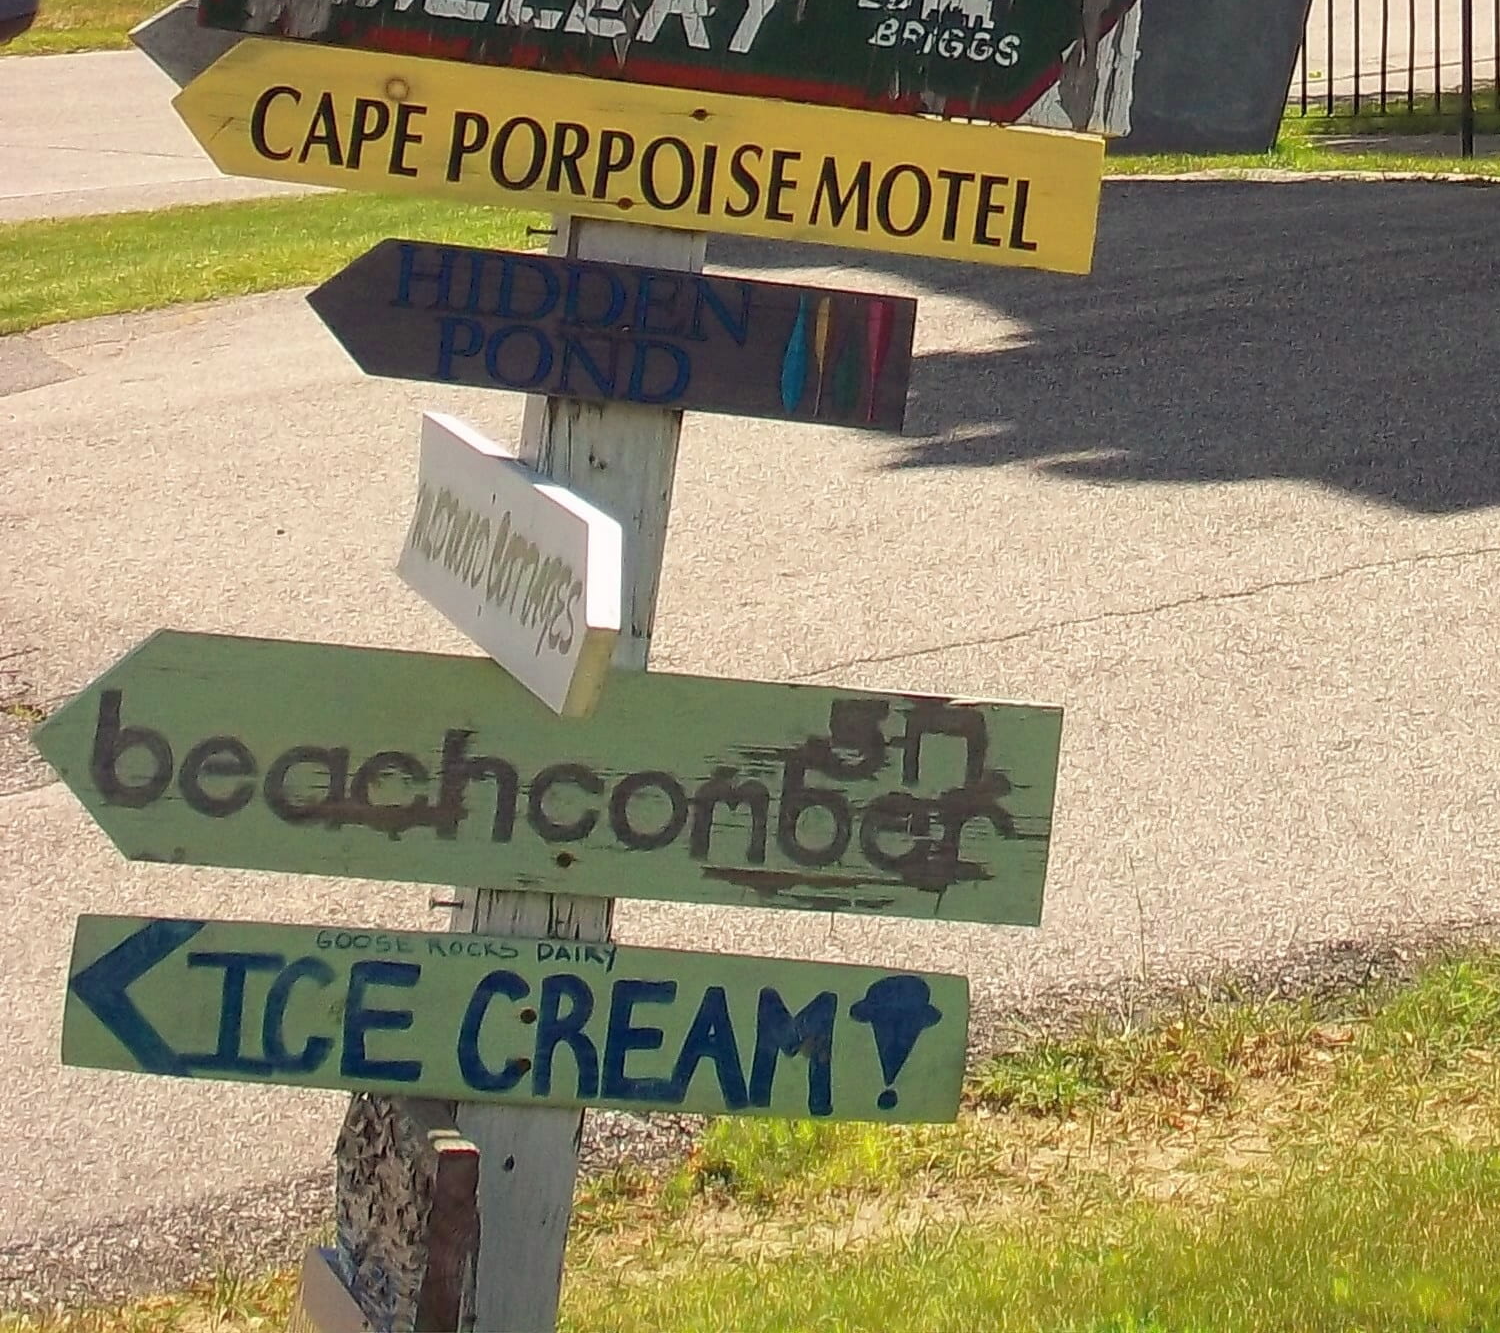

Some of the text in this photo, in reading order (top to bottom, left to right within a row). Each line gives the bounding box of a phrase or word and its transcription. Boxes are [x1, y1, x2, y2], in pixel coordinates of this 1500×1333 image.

[867, 17, 1022, 67] BRIGGS
[251, 85, 1039, 252] CAPE PORPOISE MOTEL
[387, 241, 753, 349] HIDDEN
[433, 315, 693, 405] POND
[87, 687, 1016, 883] beachcomber
[316, 929, 618, 973] GOOSE ROCKS DAIRY
[183, 950, 423, 1083] ICE
